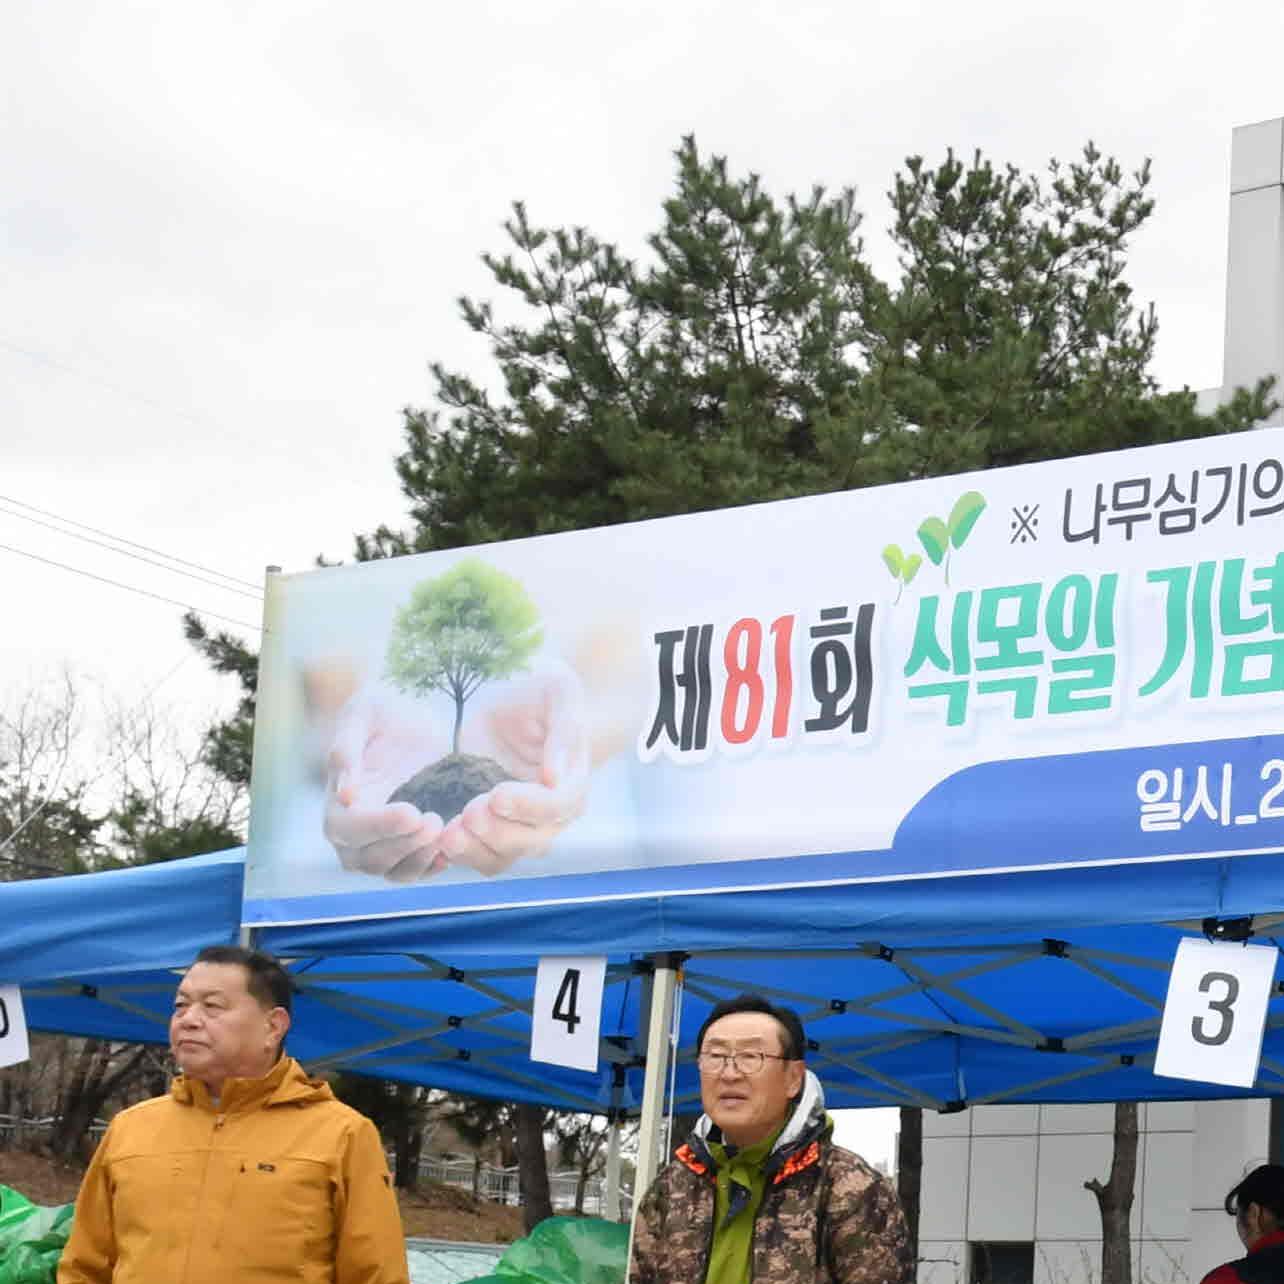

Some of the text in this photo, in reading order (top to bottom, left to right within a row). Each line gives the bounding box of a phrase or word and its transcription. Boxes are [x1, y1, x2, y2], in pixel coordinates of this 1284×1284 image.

[645, 603, 876, 752] 제81회
[903, 573, 1118, 727] 식목일
[551, 968, 581, 1034] 4
[1191, 972, 1240, 1046] 3
